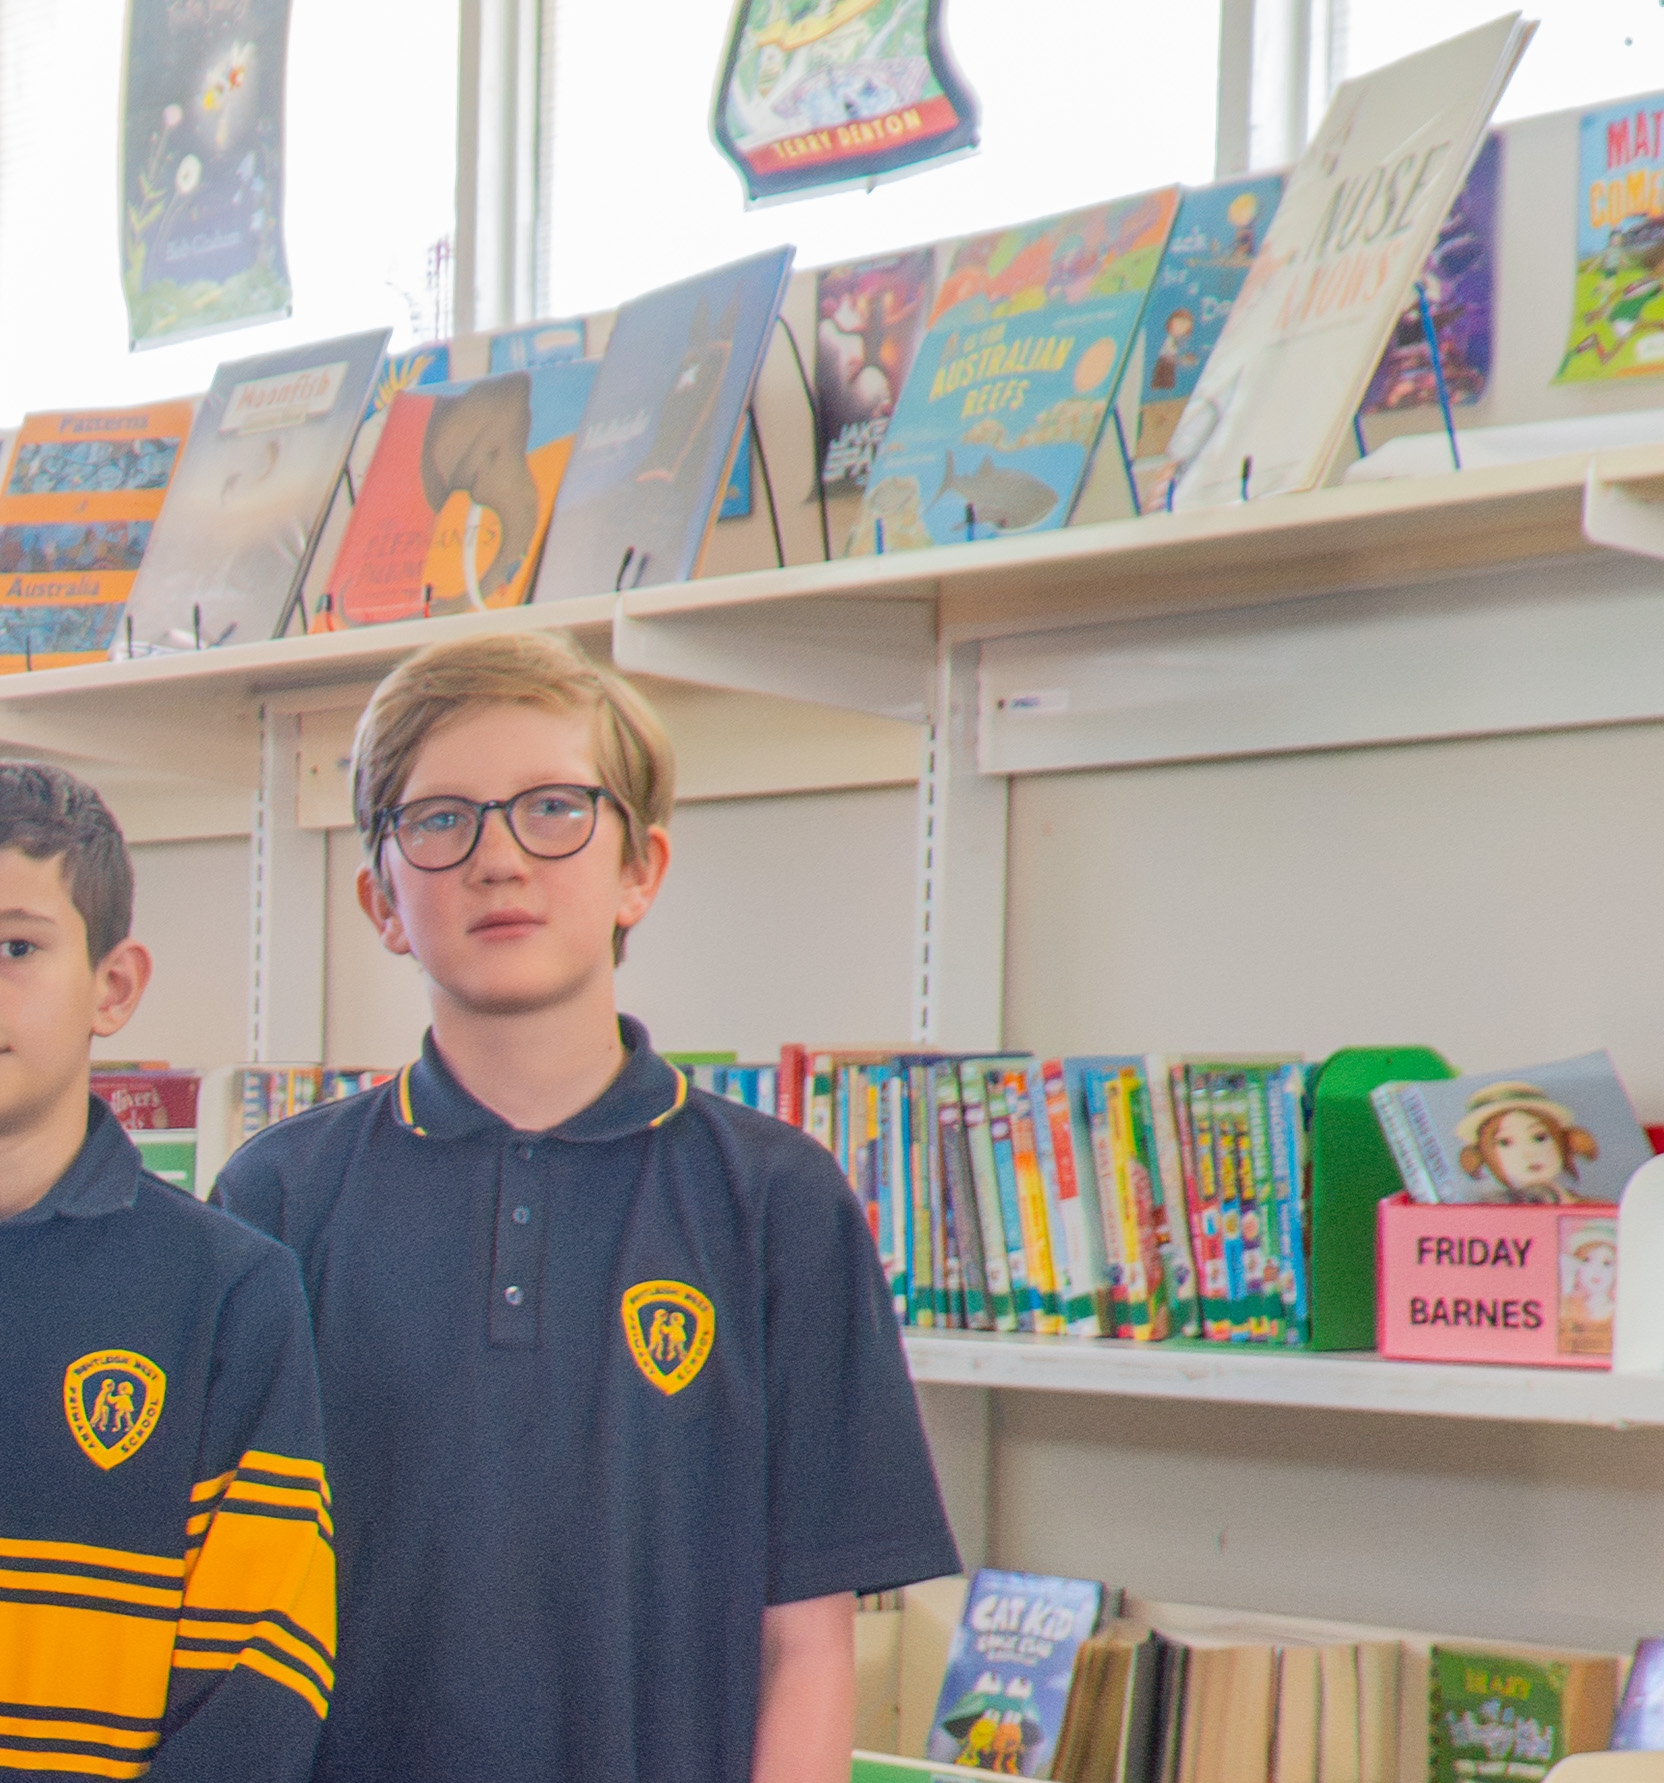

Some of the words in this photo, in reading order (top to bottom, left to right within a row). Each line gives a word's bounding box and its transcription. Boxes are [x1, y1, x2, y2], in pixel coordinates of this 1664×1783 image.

[773, 130, 833, 160] TERRY
[836, 108, 922, 146] DENTON
[928, 337, 1075, 402] AUSTRALIAN
[960, 379, 1031, 420] REEFS
[58, 413, 151, 434] Patterns
[5, 577, 100, 599] Australia
[1416, 1236, 1534, 1268] FRIDAY
[1409, 1297, 1544, 1331] BARNES
[120, 1399, 160, 1453] SCHOOL
[970, 1594, 1027, 1632] CAT
